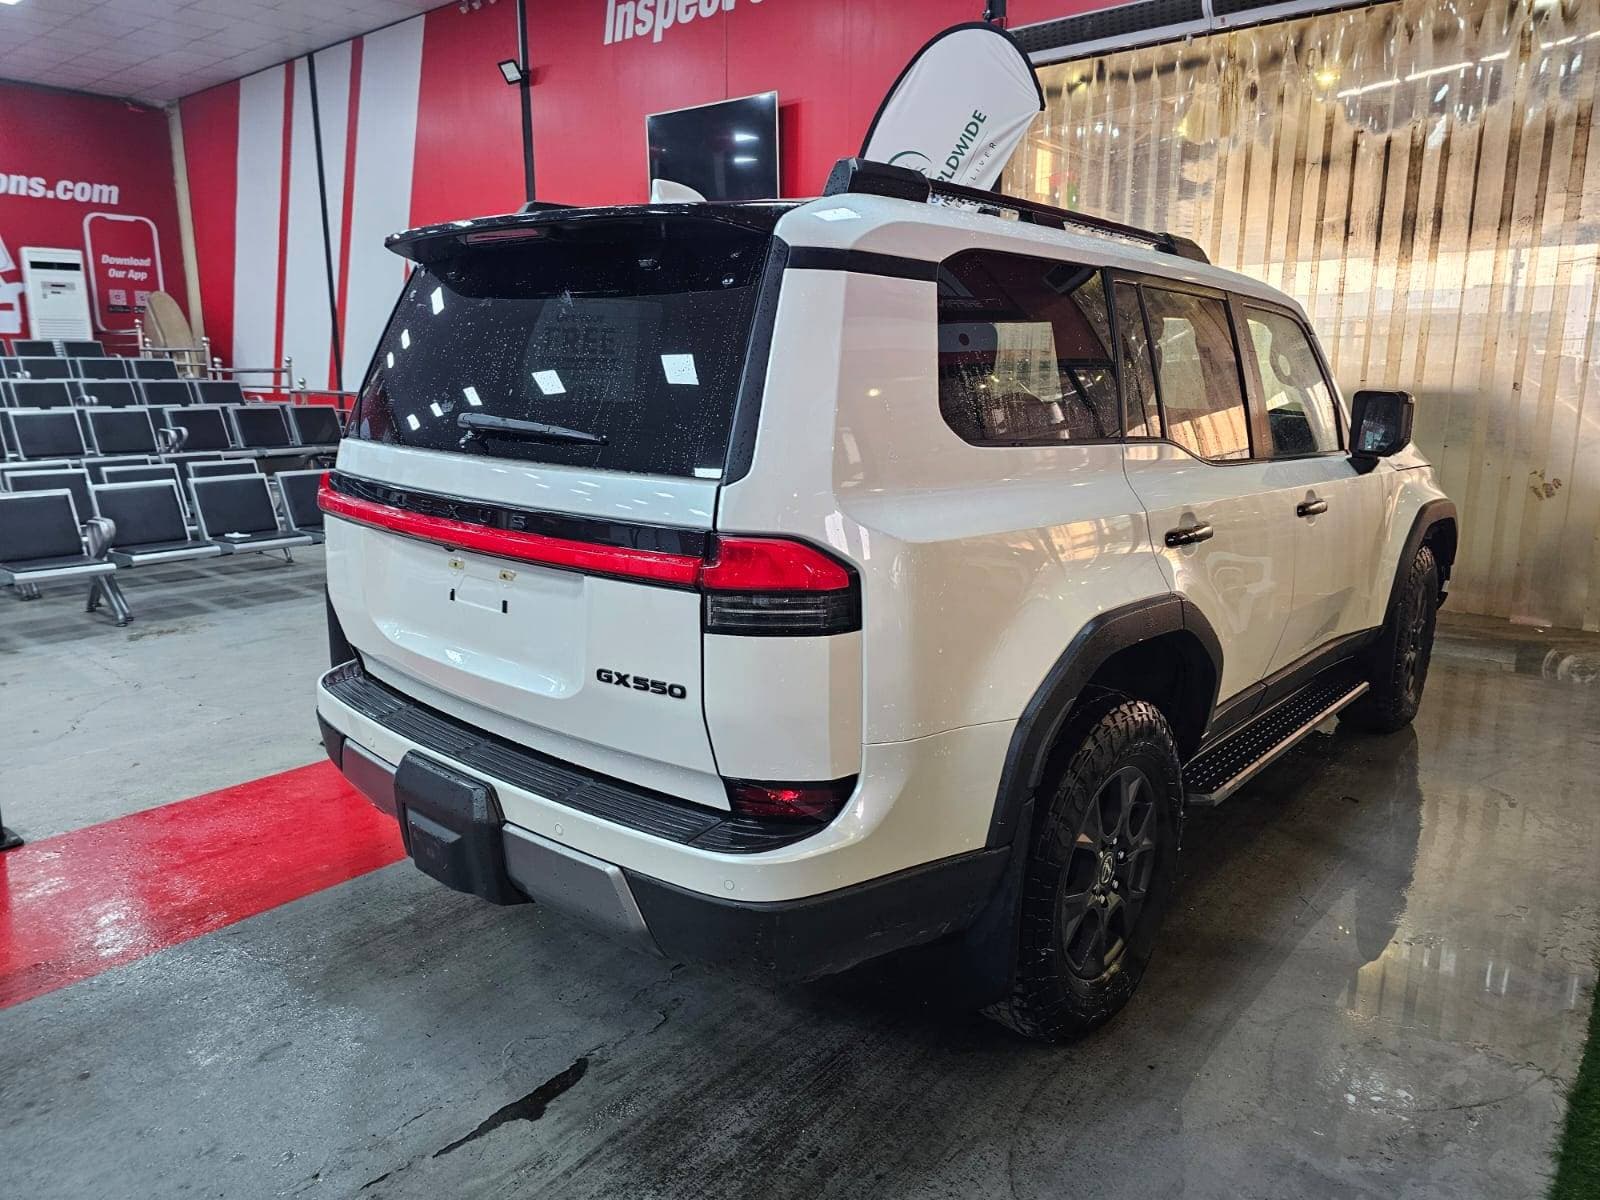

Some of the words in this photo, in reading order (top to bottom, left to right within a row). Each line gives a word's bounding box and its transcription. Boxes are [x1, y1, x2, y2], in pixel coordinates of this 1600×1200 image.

[604, 0, 736, 45] Inspe
[101, 254, 151, 267] Download
[108, 268, 126, 279] Our
[128, 269, 147, 281] App
[596, 668, 687, 699] GX550
